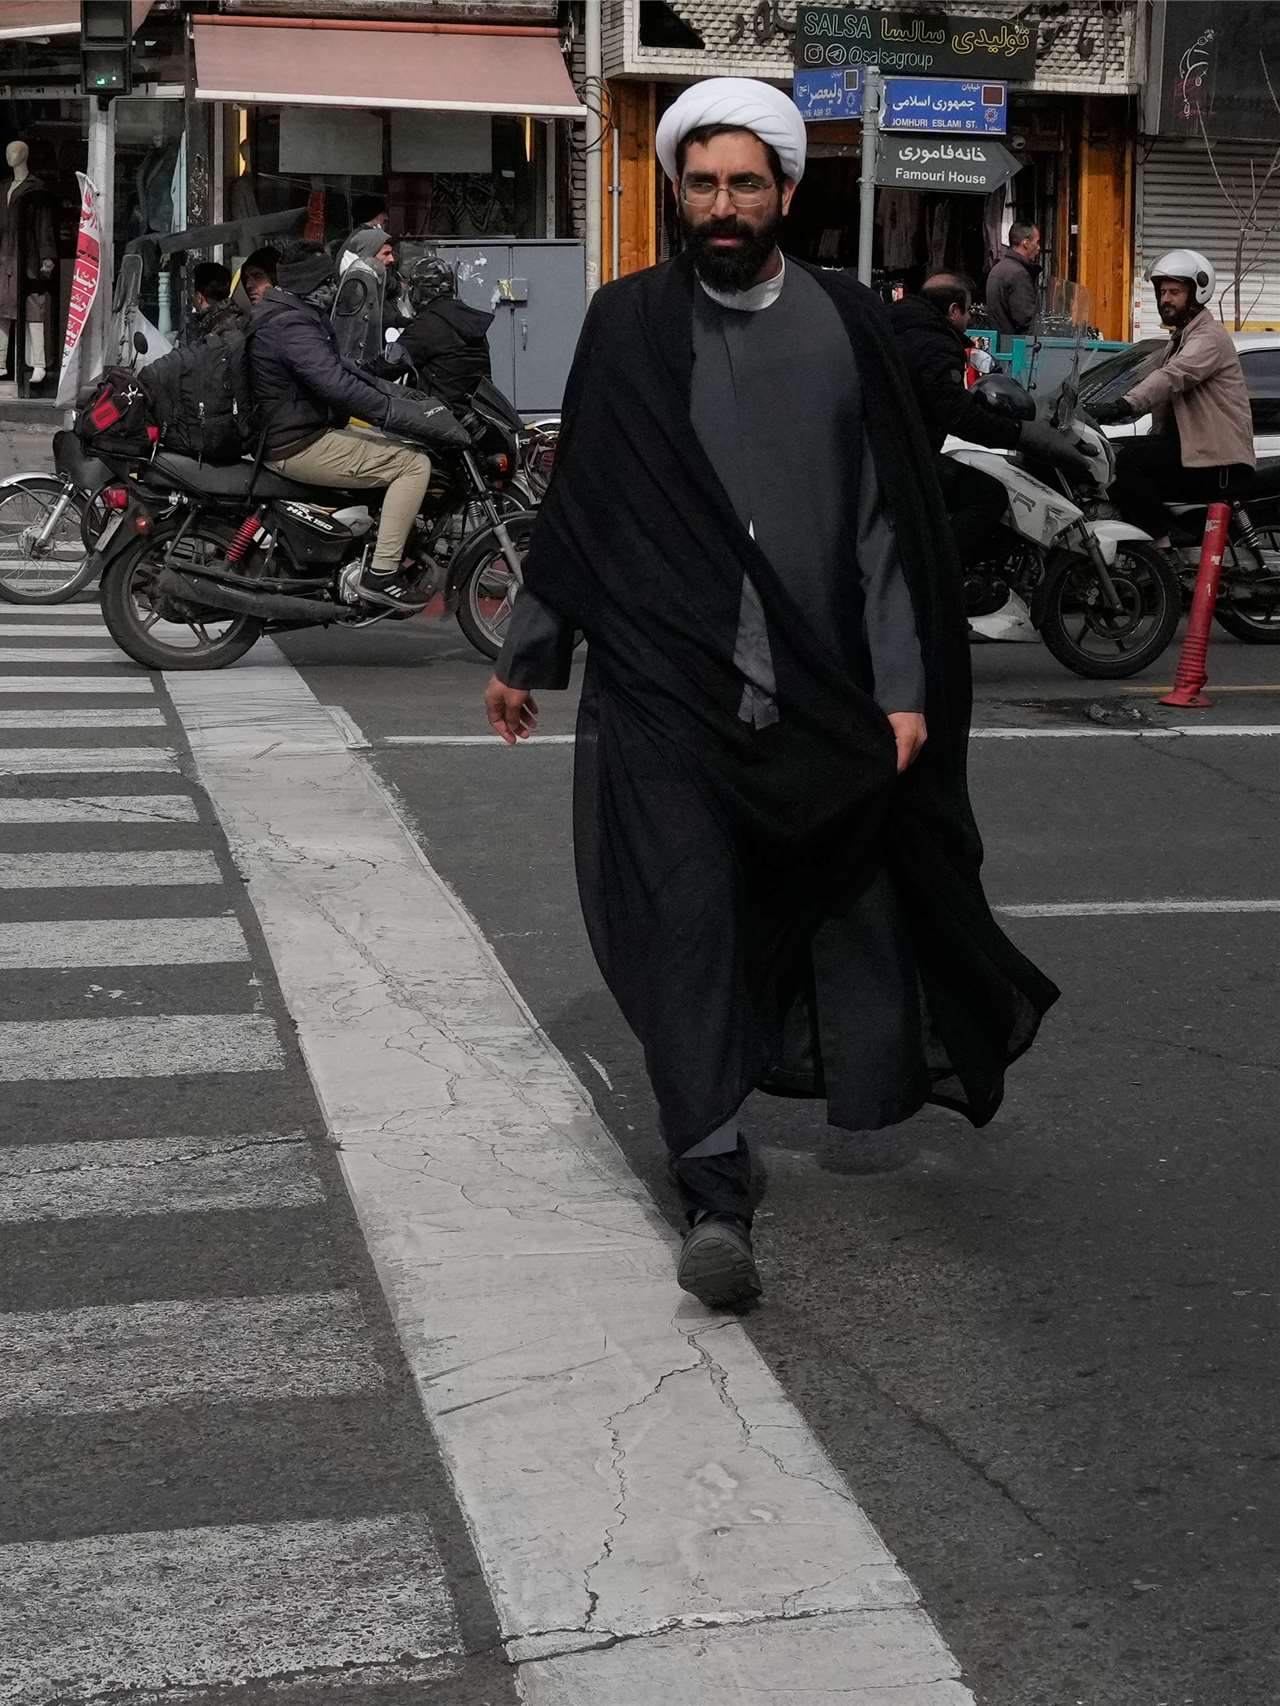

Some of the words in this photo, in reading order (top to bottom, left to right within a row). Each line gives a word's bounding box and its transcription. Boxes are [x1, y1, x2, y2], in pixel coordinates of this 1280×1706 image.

[803, 11, 871, 39] SALSA
[880, 17, 946, 44] سالسا
[951, 25, 1030, 57] تولیدی
[848, 46, 934, 70] @salsagroup
[807, 82, 842, 108] ولیعصر
[960, 83, 981, 93] خیابان
[892, 95, 931, 111] اسلامی
[932, 98, 977, 112] جمهوری
[892, 118, 928, 127] JOMHURI
[932, 119, 962, 128] ESLAMI
[965, 119, 978, 129] ST.
[895, 167, 945, 182] Famouri
[948, 171, 987, 185] House
